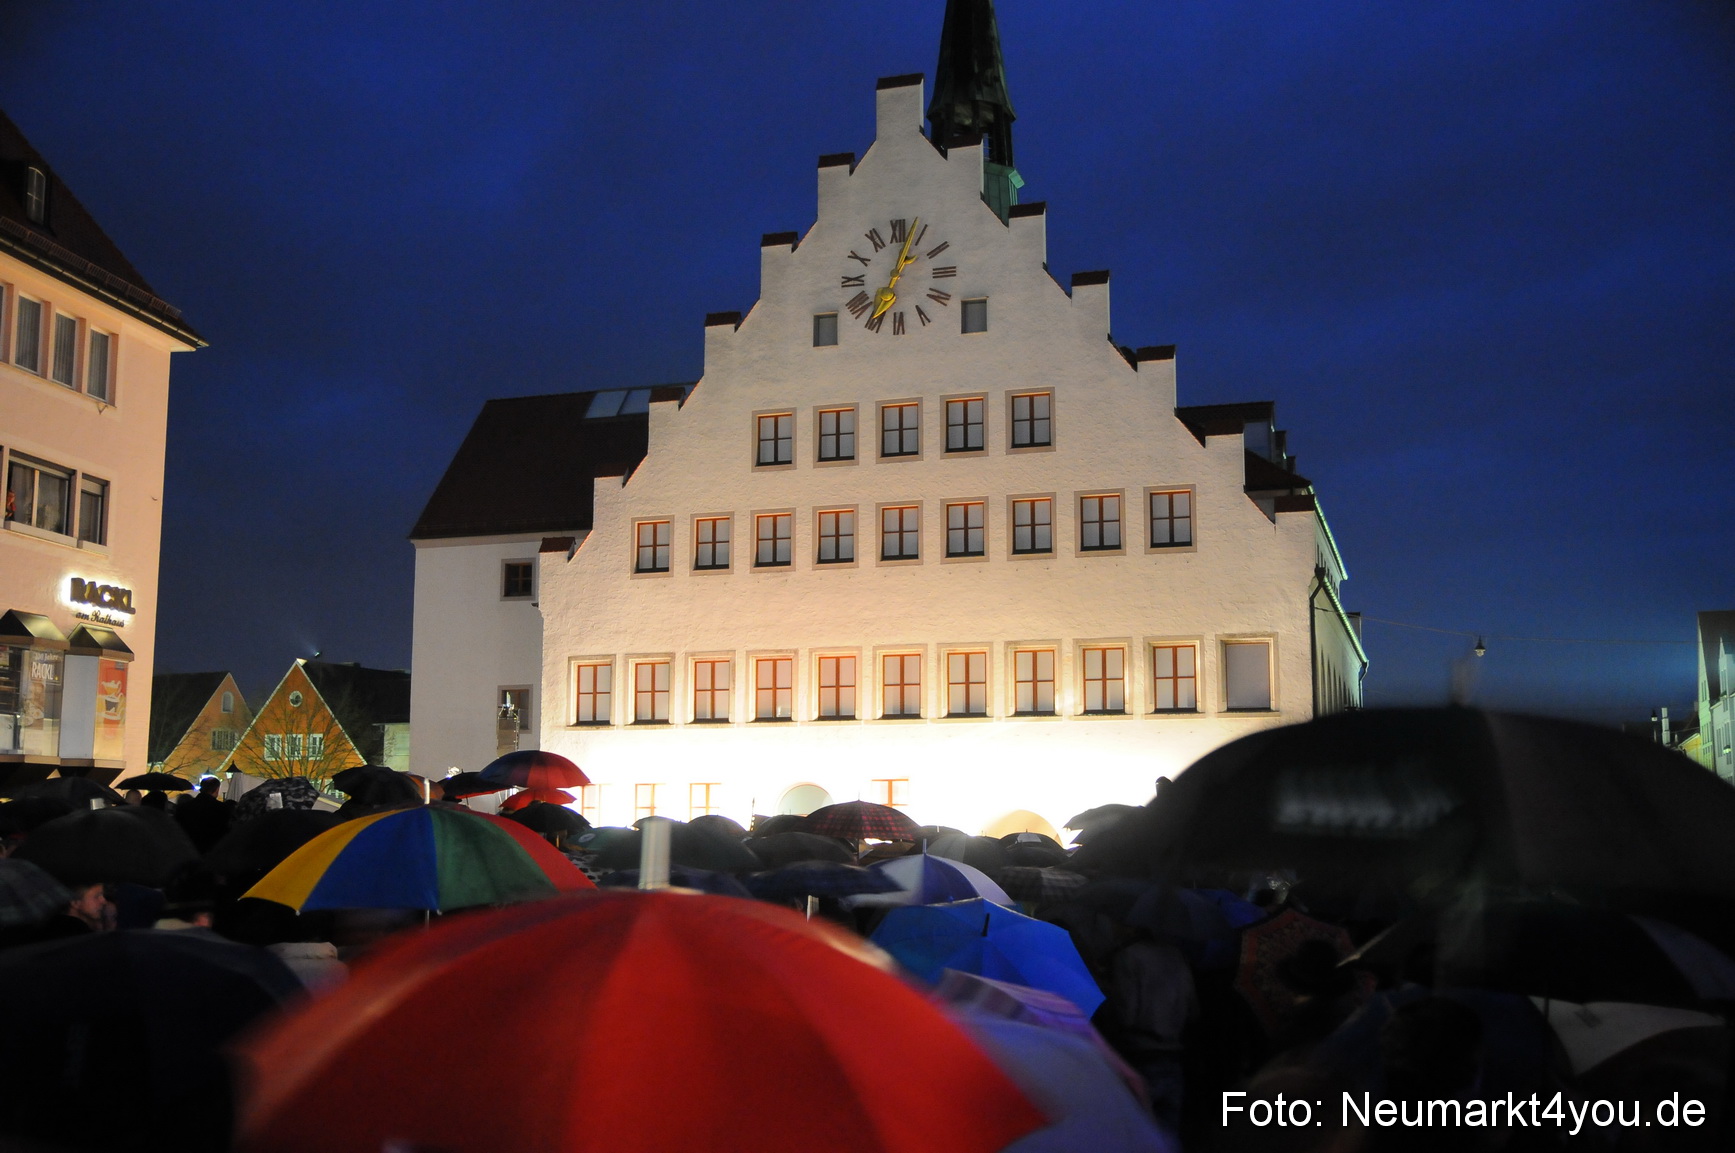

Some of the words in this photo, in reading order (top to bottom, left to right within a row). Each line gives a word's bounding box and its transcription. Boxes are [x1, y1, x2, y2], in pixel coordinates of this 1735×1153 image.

[865, 228, 886, 253] XI
[890, 219, 906, 244] XII
[915, 224, 928, 246] I
[847, 250, 871, 267] X
[926, 241, 950, 259] II
[841, 274, 865, 288] IX
[932, 266, 957, 279] III
[845, 290, 873, 320] VIII
[926, 287, 951, 306] IV
[893, 311, 905, 335] VI
[915, 304, 931, 326] V
[70, 577, 136, 615] RACKL
[75, 612, 90, 621] am
[90, 610, 125, 628] Rathaus
